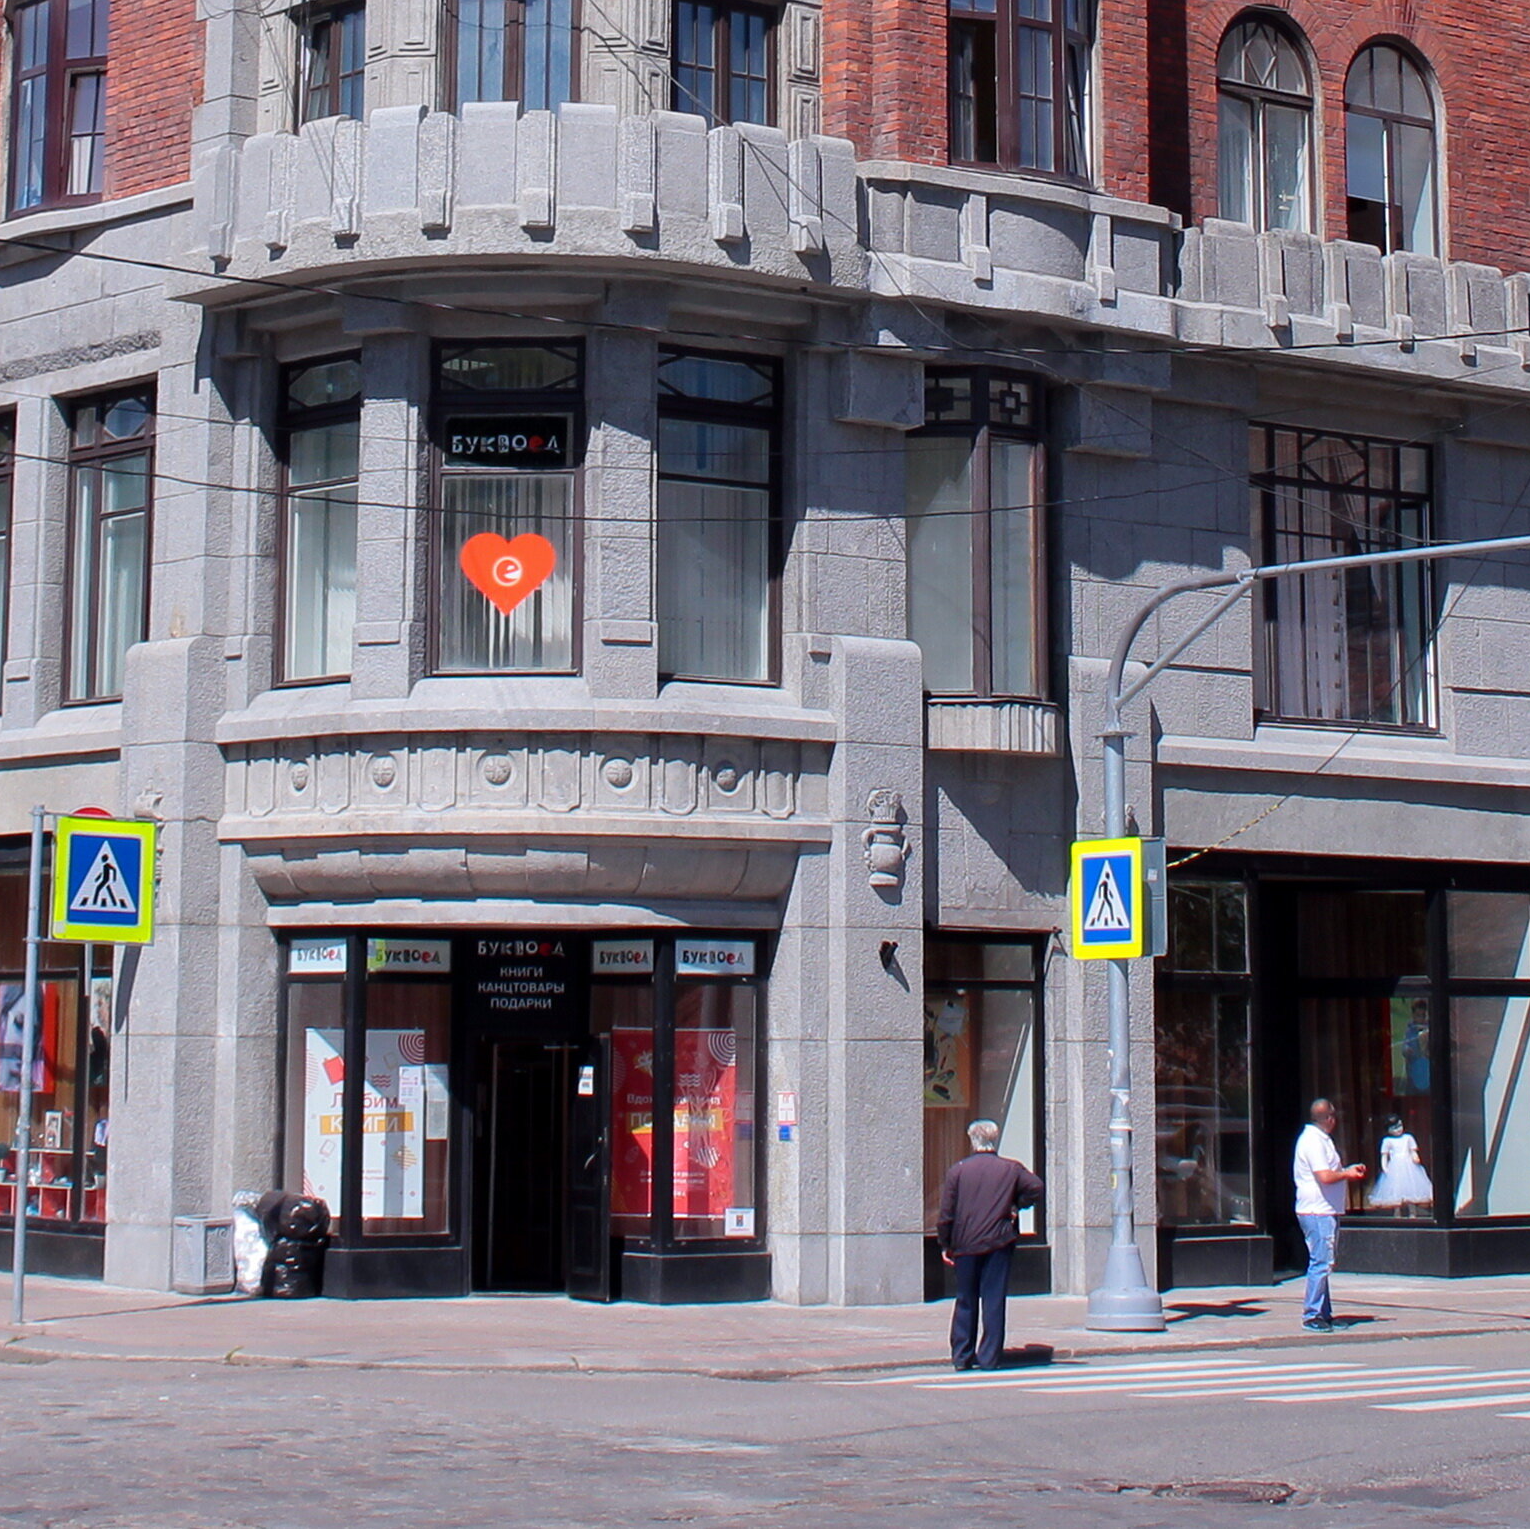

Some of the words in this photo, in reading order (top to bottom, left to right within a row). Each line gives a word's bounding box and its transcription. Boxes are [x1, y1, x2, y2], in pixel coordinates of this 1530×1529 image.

[499, 966, 544, 978] КНИГИ
[477, 981, 566, 995] КАНЦТОВАРЫ
[489, 997, 553, 1010] ПОДАРКИ
[330, 1092, 399, 1109] Лбим
